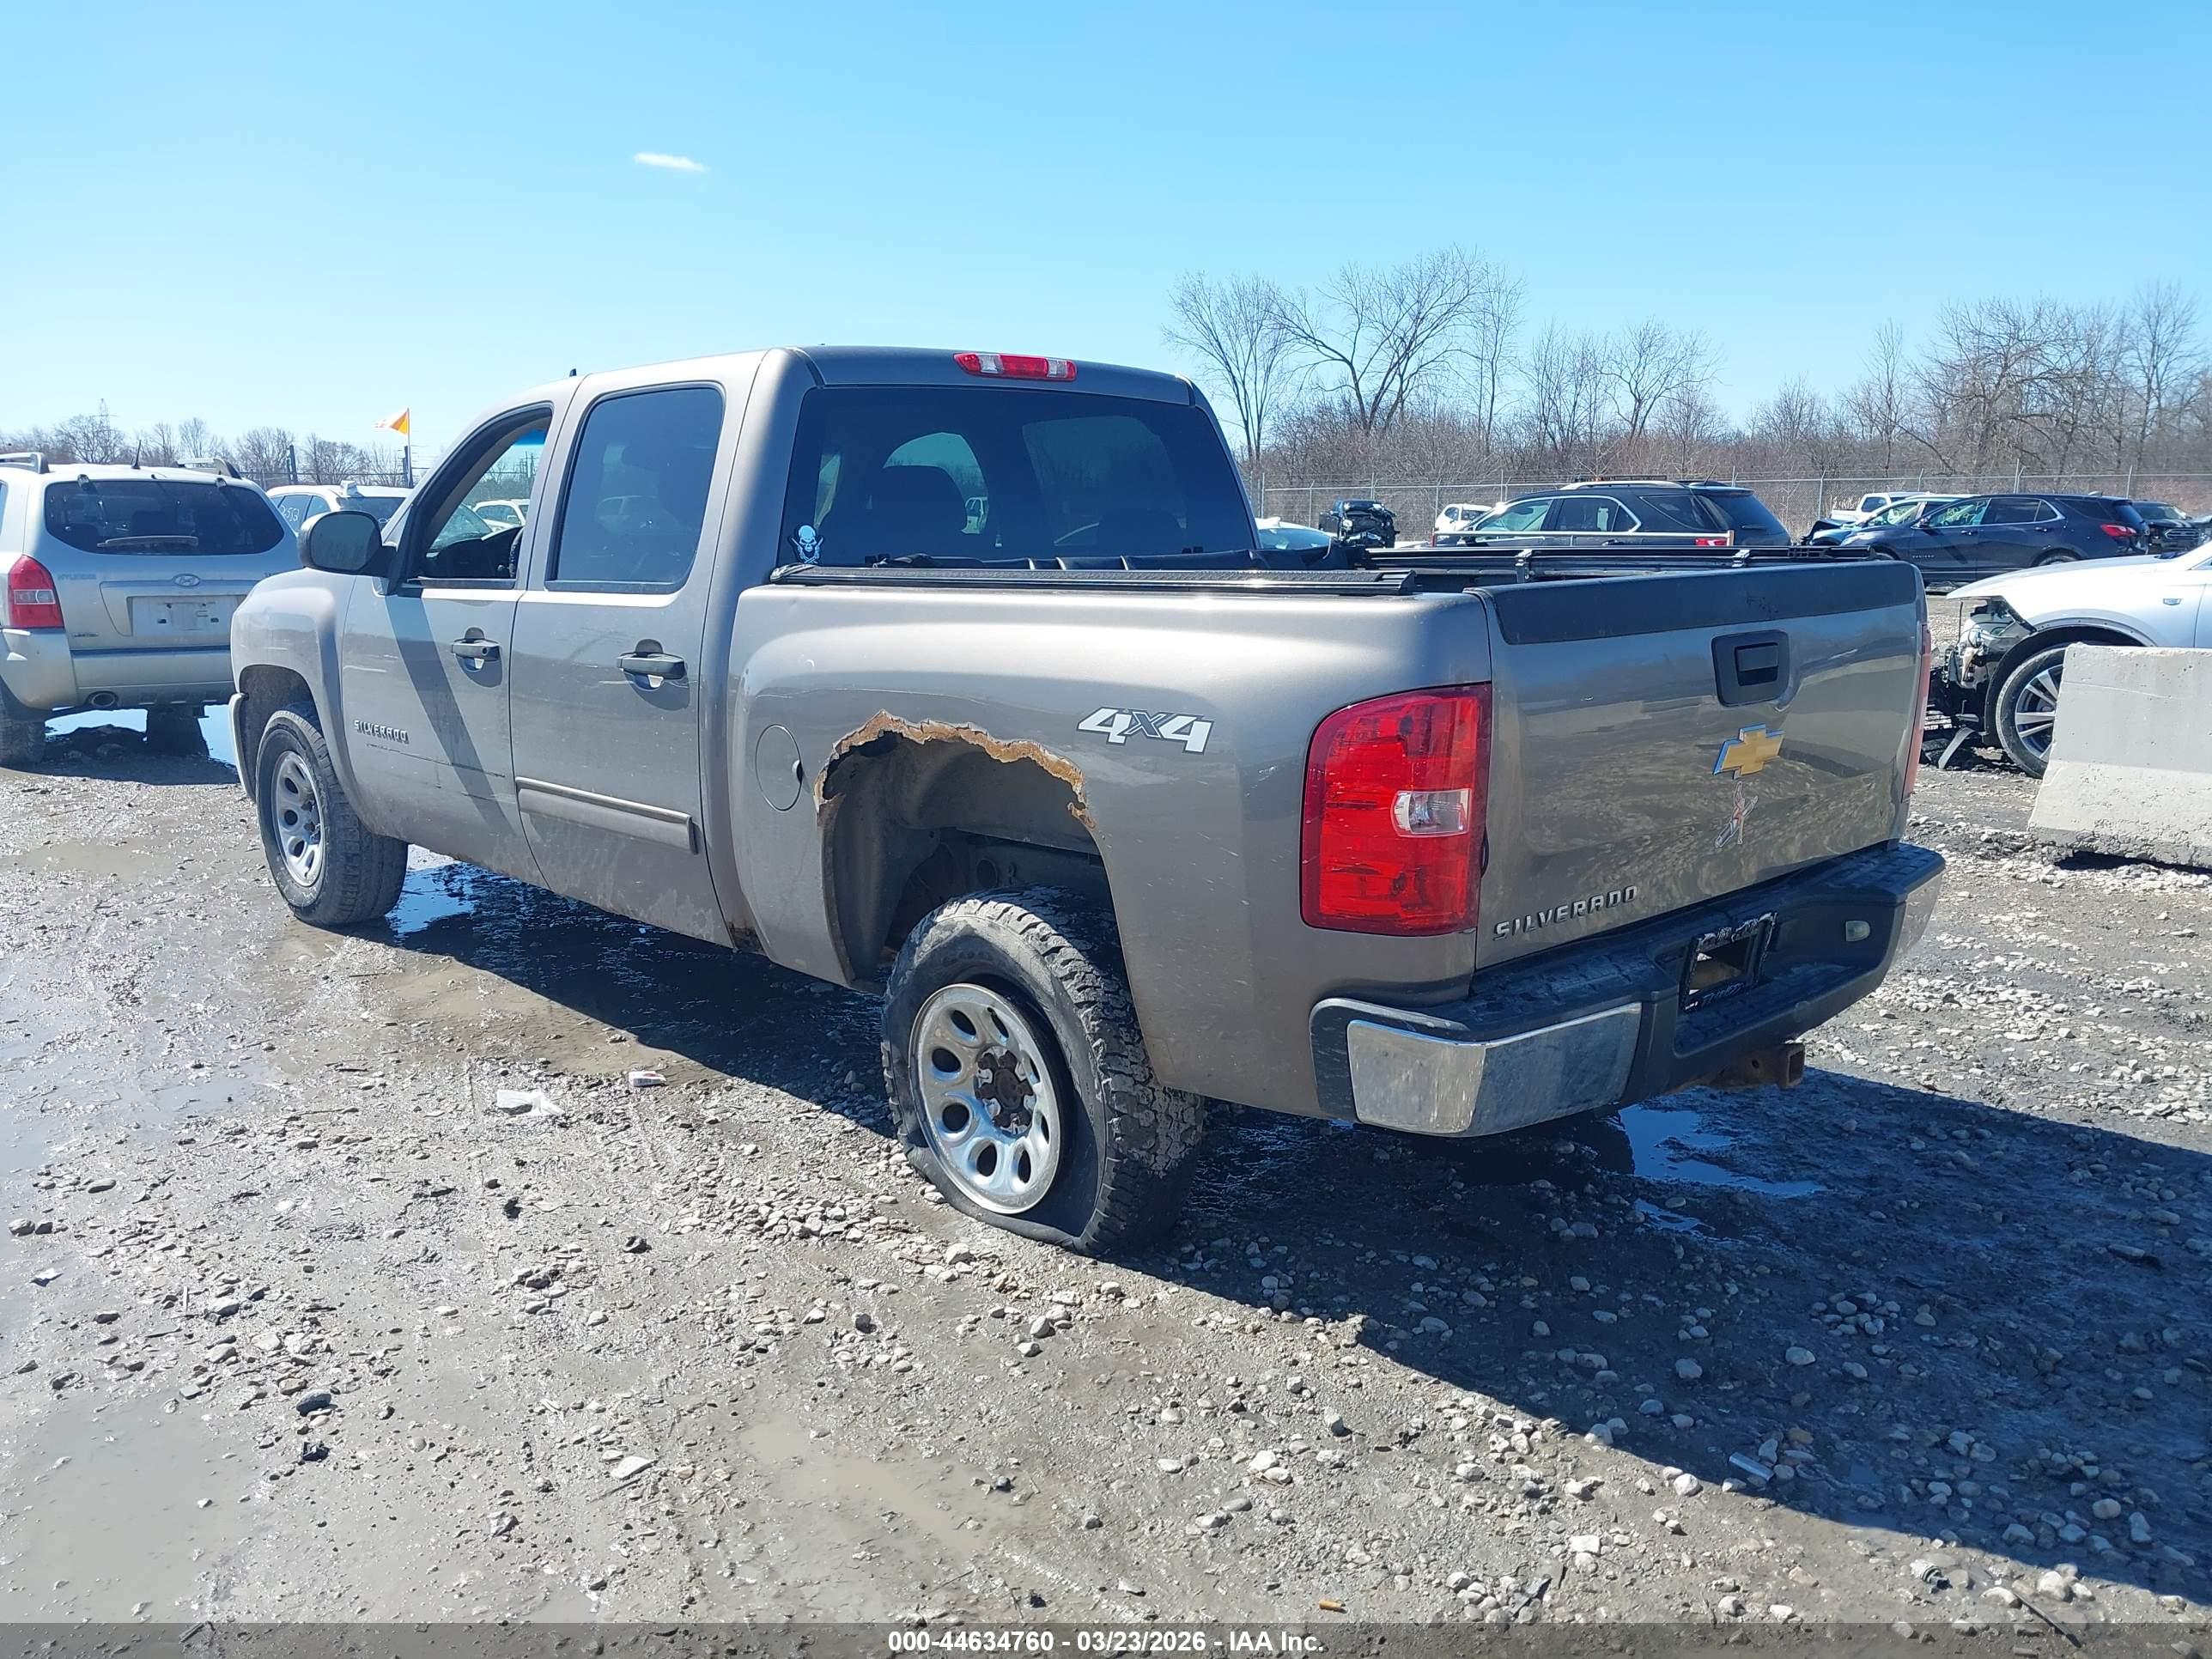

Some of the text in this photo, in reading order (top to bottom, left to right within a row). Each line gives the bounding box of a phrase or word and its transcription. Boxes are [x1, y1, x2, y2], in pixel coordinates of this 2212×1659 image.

[354, 720, 409, 744] SILVERADO
[1077, 707, 1215, 754] 4X4
[1493, 885, 1638, 940] SILVERADO
